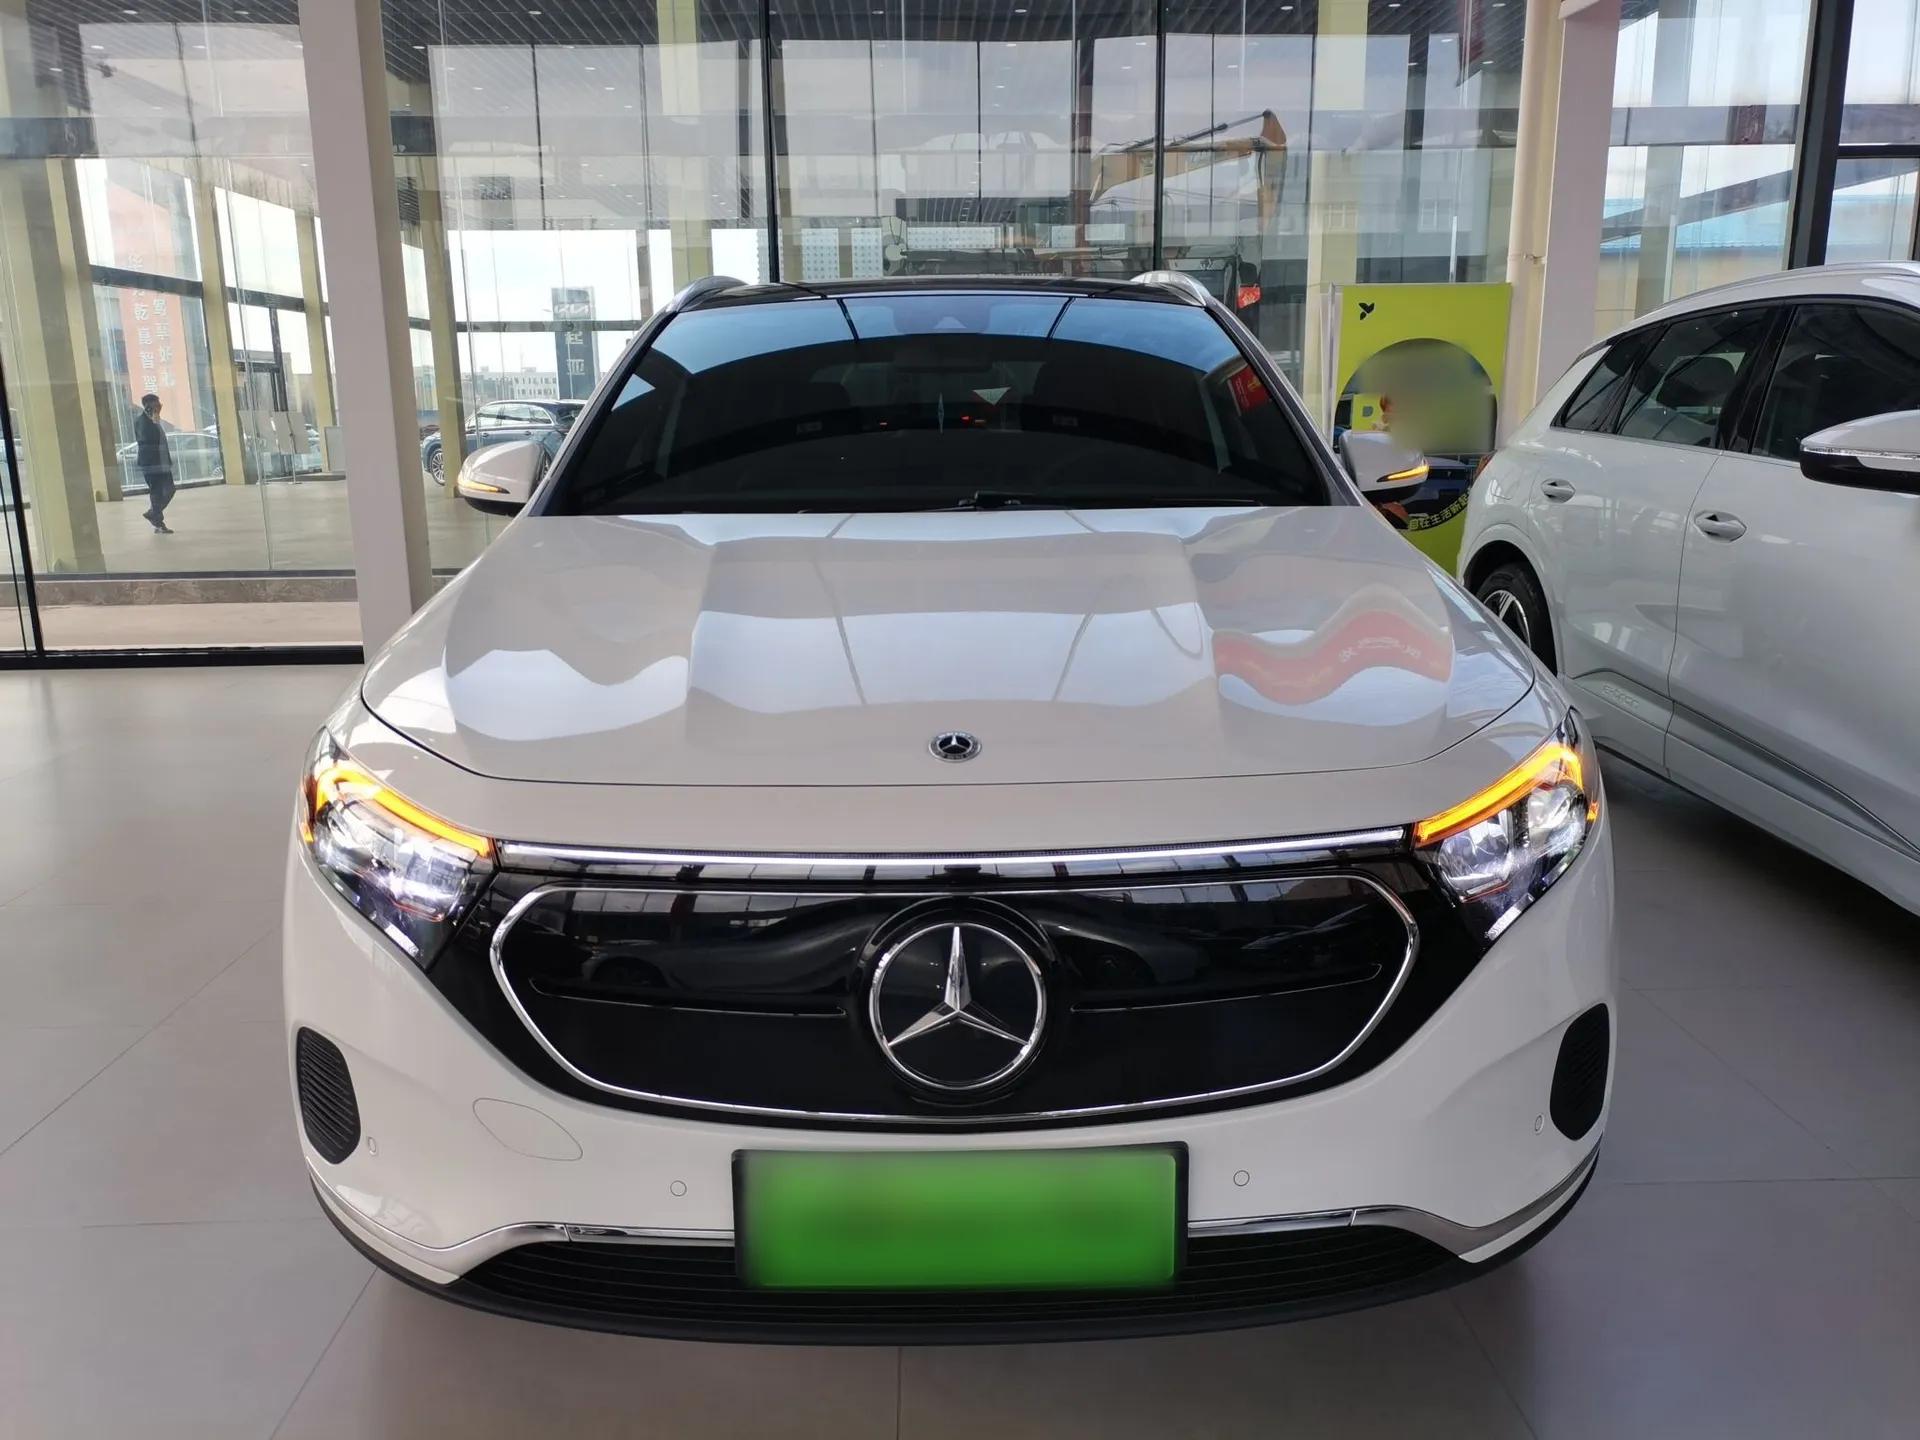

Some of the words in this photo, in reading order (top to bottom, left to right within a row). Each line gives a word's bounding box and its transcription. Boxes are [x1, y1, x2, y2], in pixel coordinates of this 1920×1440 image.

[553, 303, 590, 314] KIA
[564, 331, 586, 376] 起亚
[1409, 489, 1471, 530] 自在生活新起
